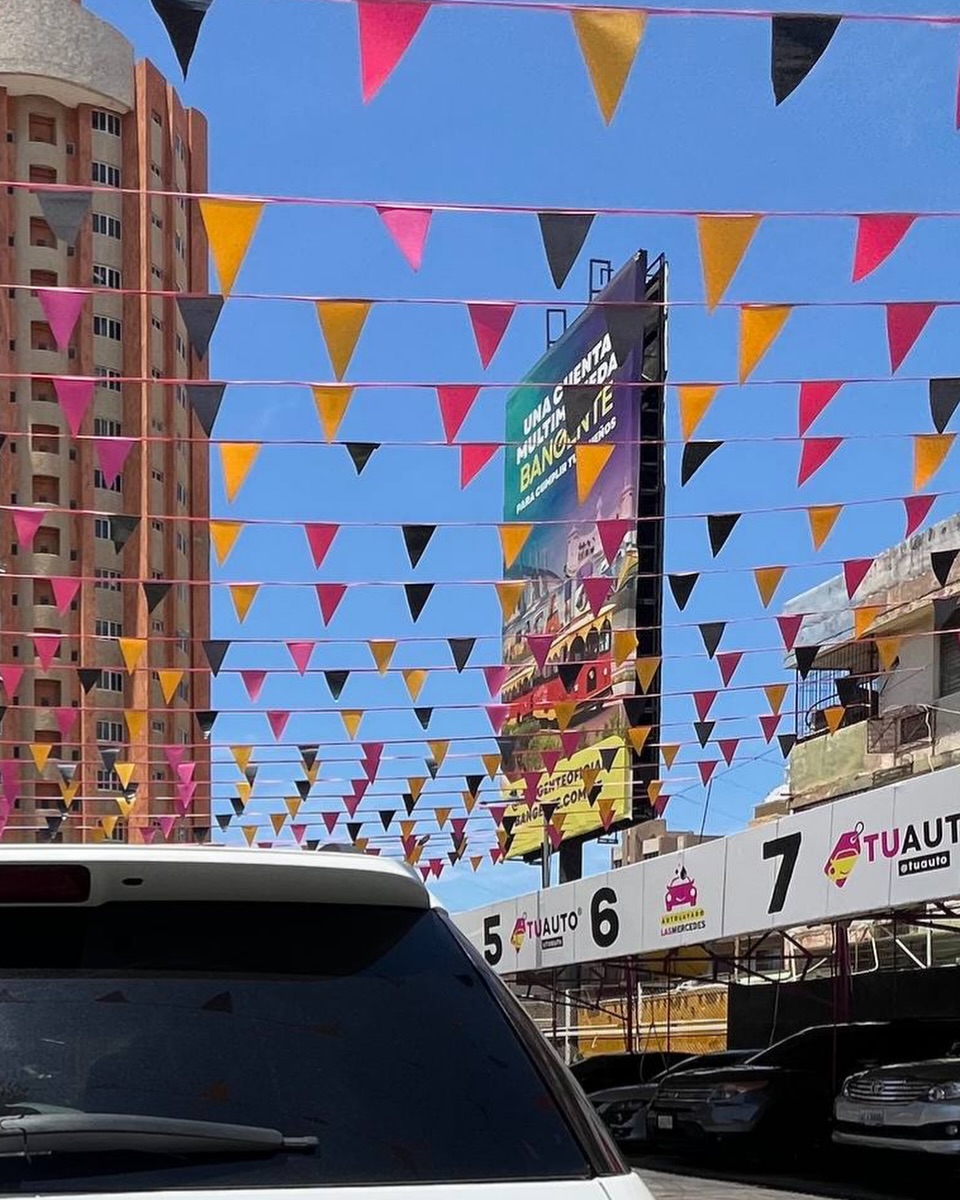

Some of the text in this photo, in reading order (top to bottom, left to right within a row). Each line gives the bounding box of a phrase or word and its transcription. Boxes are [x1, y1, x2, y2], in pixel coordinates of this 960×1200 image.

[523, 395, 552, 435] UNA
[516, 491, 535, 515] PARA
[762, 831, 803, 915] 7
[900, 856, 948, 874] @tuauto
[590, 886, 620, 948] 6
[483, 914, 503, 967] 5
